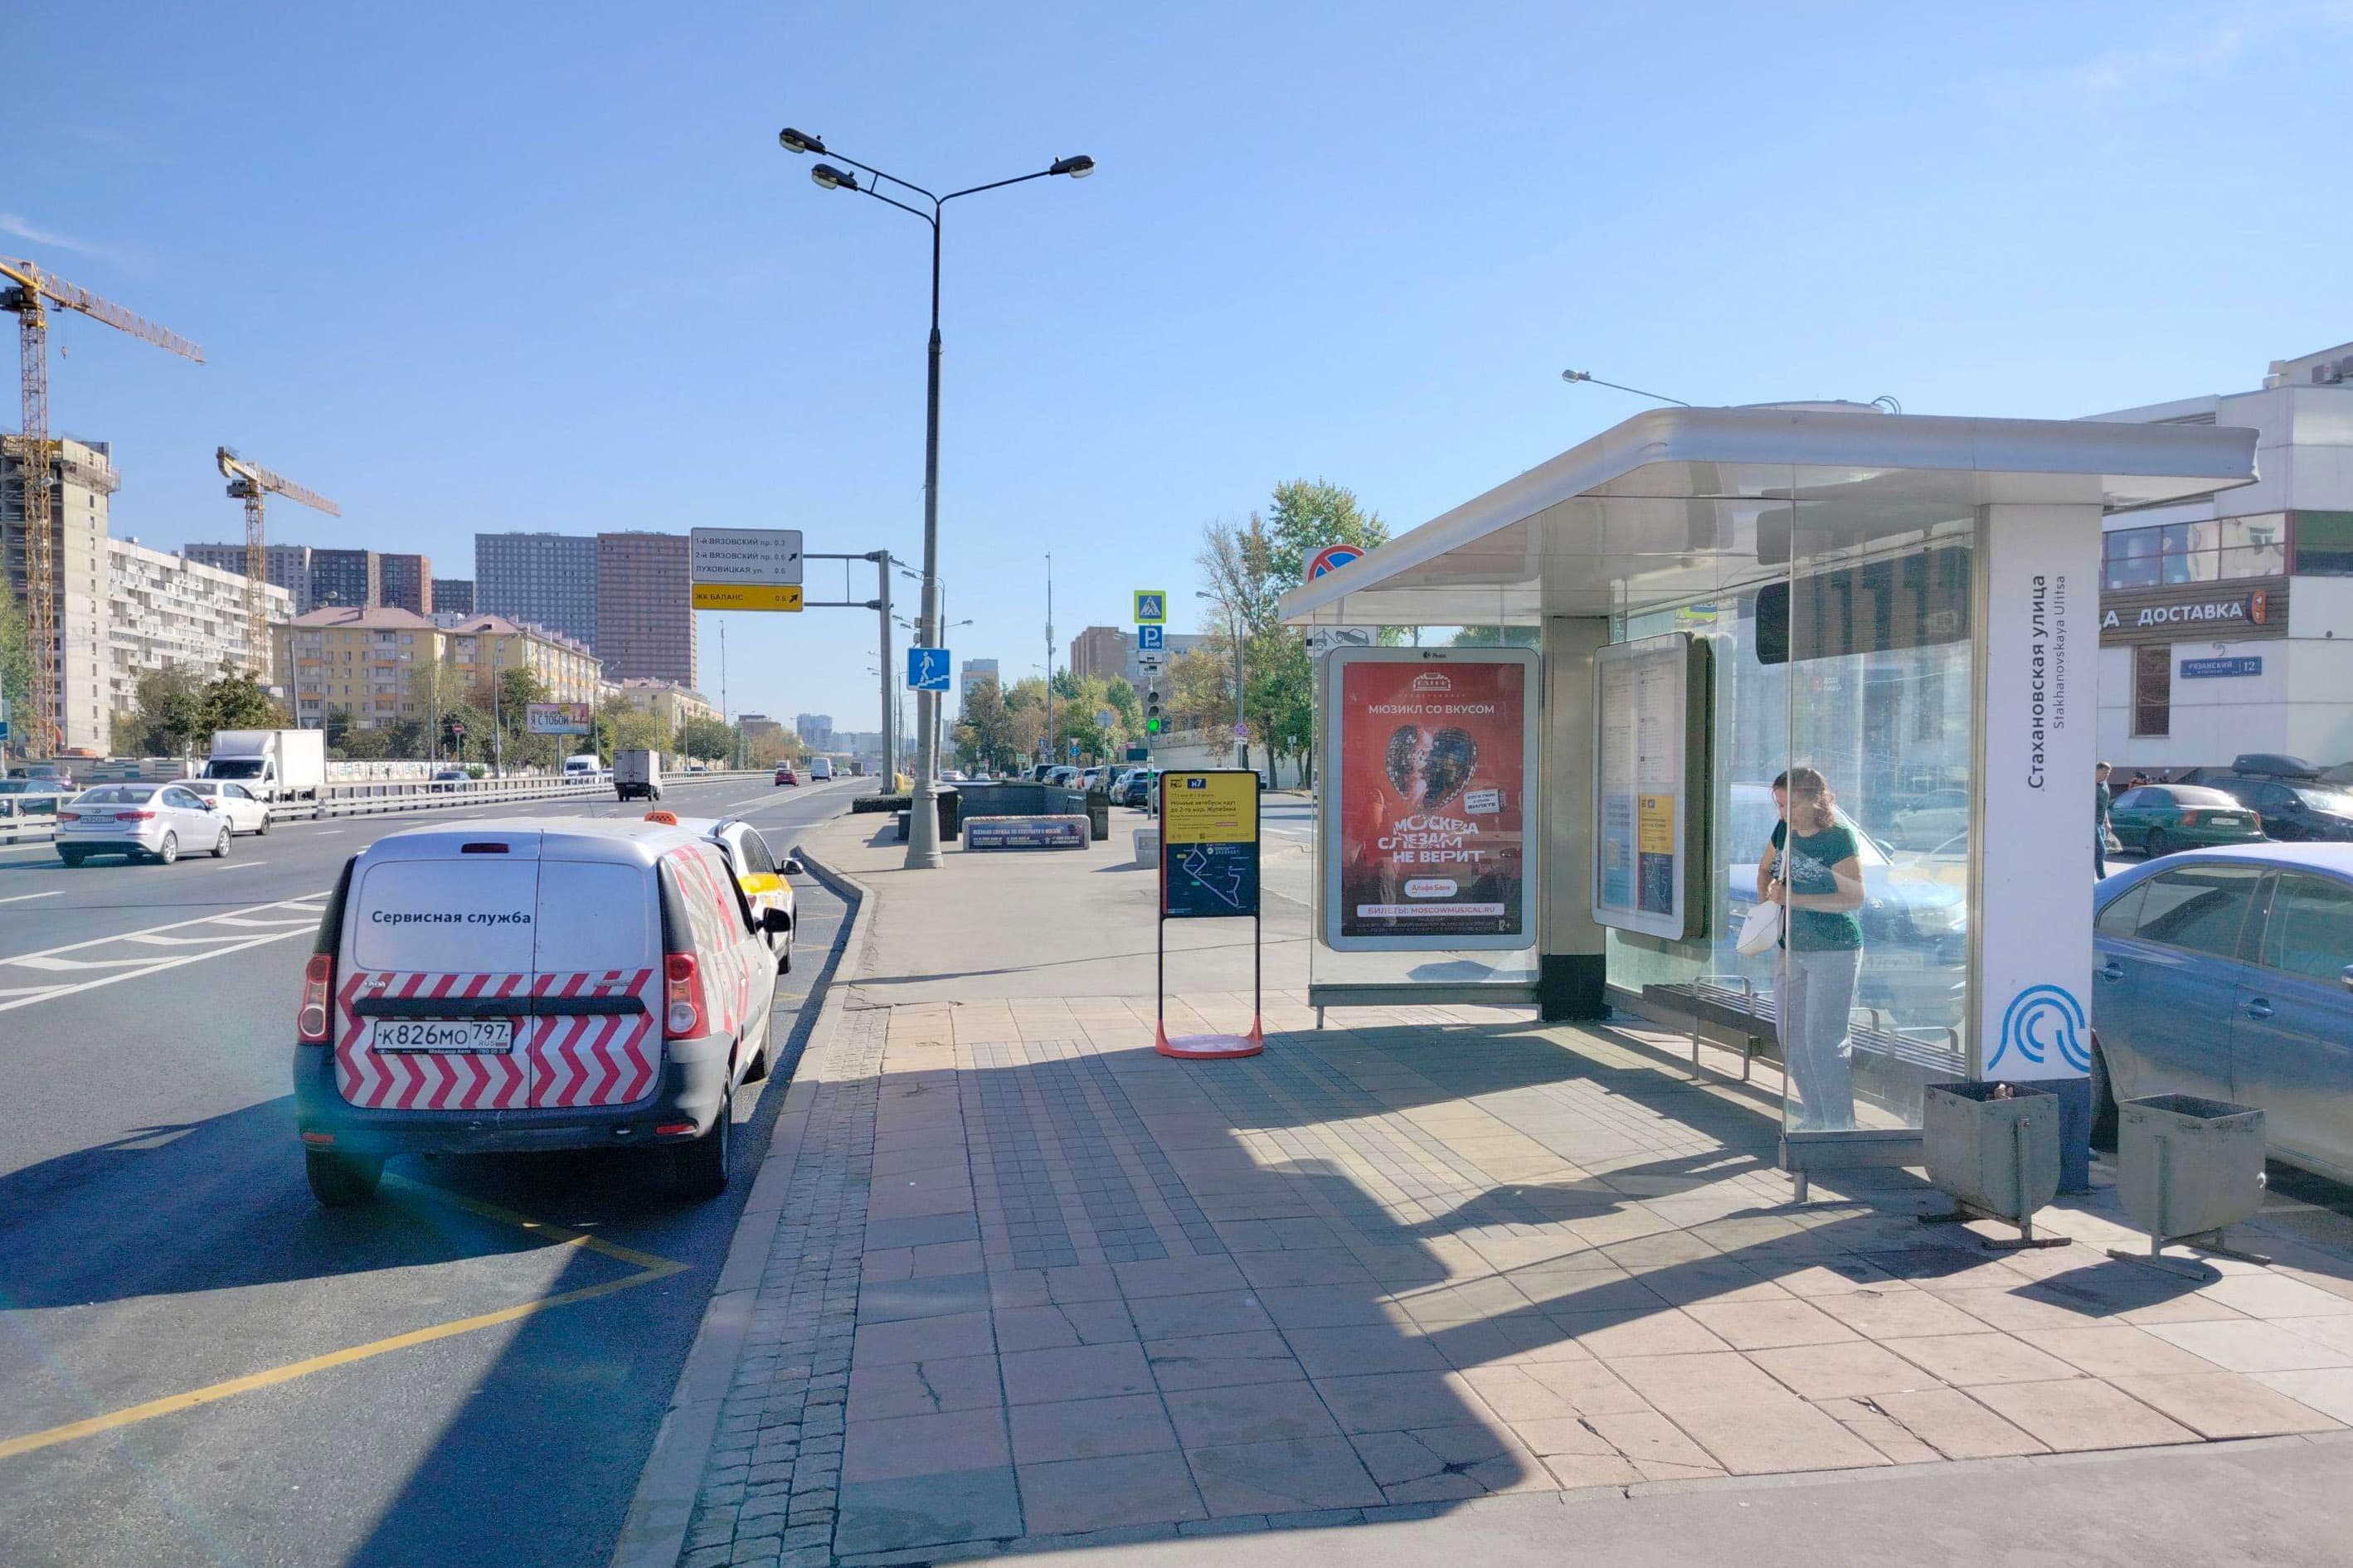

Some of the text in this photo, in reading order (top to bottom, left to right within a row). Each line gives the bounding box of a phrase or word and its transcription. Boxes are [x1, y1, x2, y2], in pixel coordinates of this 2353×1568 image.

[709, 537, 758, 546] ВЯЗОВСКИЙ
[709, 551, 758, 560] ВЯЗОВСКИЙ
[696, 566, 751, 574] ПУХОВИЦКАЯ
[2137, 602, 2243, 627] ДОСТАВКА
[2053, 575, 2068, 730] Stakhanovskaya Ulitsa
[2244, 662, 2255, 672] 12
[2027, 575, 2049, 789] Стахановская улица
[1369, 705, 1495, 714] МЮЗИКЛ СО ВКУСОМ
[1393, 813, 1480, 836] МОСКВА
[1378, 833, 1462, 850] СЛЕЗАМ
[1393, 850, 1485, 863] НЕ ВЕРИТ
[372, 910, 532, 926] Сервисная служба
[472, 1023, 506, 1040] 797
